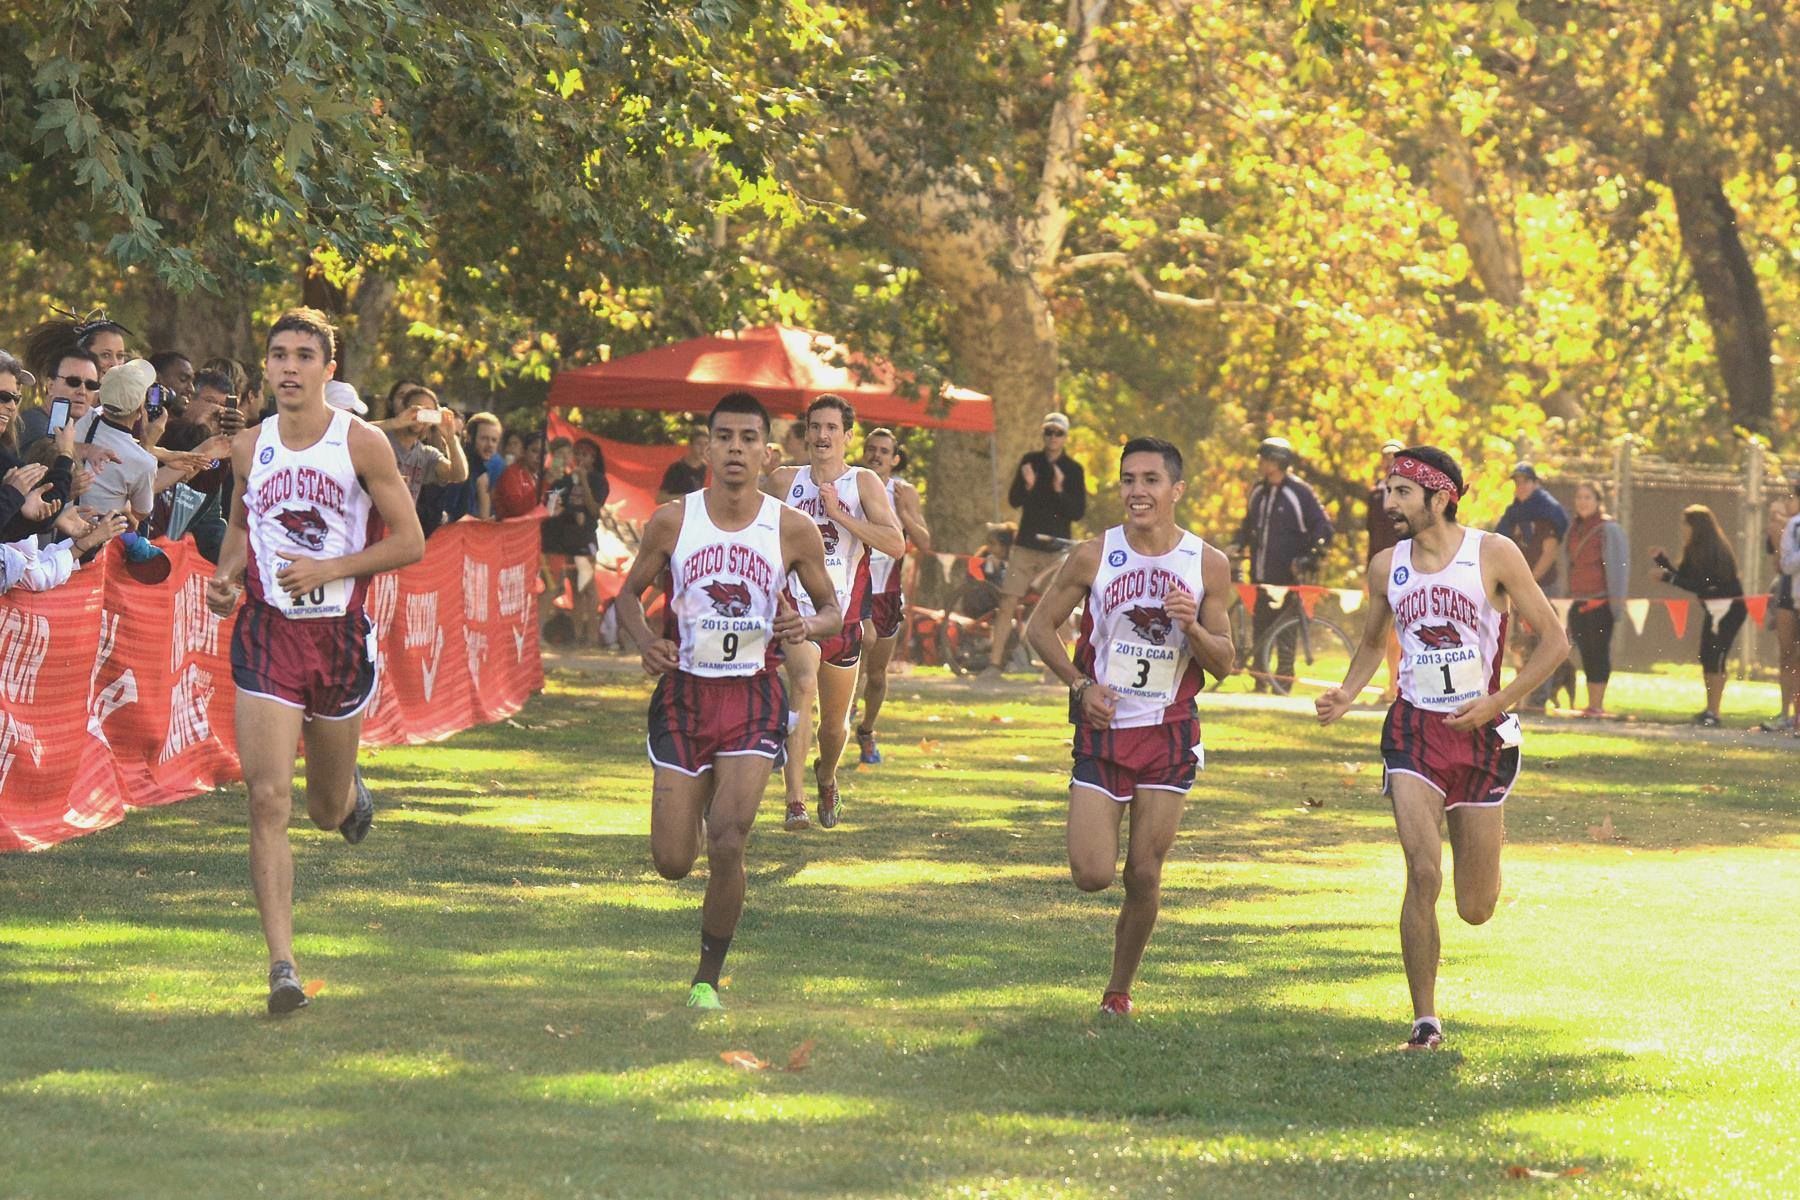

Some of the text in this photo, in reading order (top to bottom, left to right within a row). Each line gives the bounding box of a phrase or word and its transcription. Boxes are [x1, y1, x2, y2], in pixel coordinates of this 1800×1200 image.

[297, 467, 345, 517] STATE
[683, 543, 772, 597] CHICO STATE
[825, 557, 842, 567] CAA
[1103, 568, 1145, 616] CHICO
[1396, 586, 1478, 632] HICO STATE
[701, 619, 762, 632] 2013 CCAA
[0, 606, 51, 704] OUR
[722, 632, 739, 662] 9
[1115, 642, 1175, 661] 2013 CCAA
[1416, 649, 1476, 665] 2013 CCAA
[697, 661, 760, 671] CHAMPIONSHIPS
[1131, 658, 1151, 689] 3
[1439, 663, 1456, 695] 1
[1421, 690, 1482, 705] CHAMPIONSHIPS
